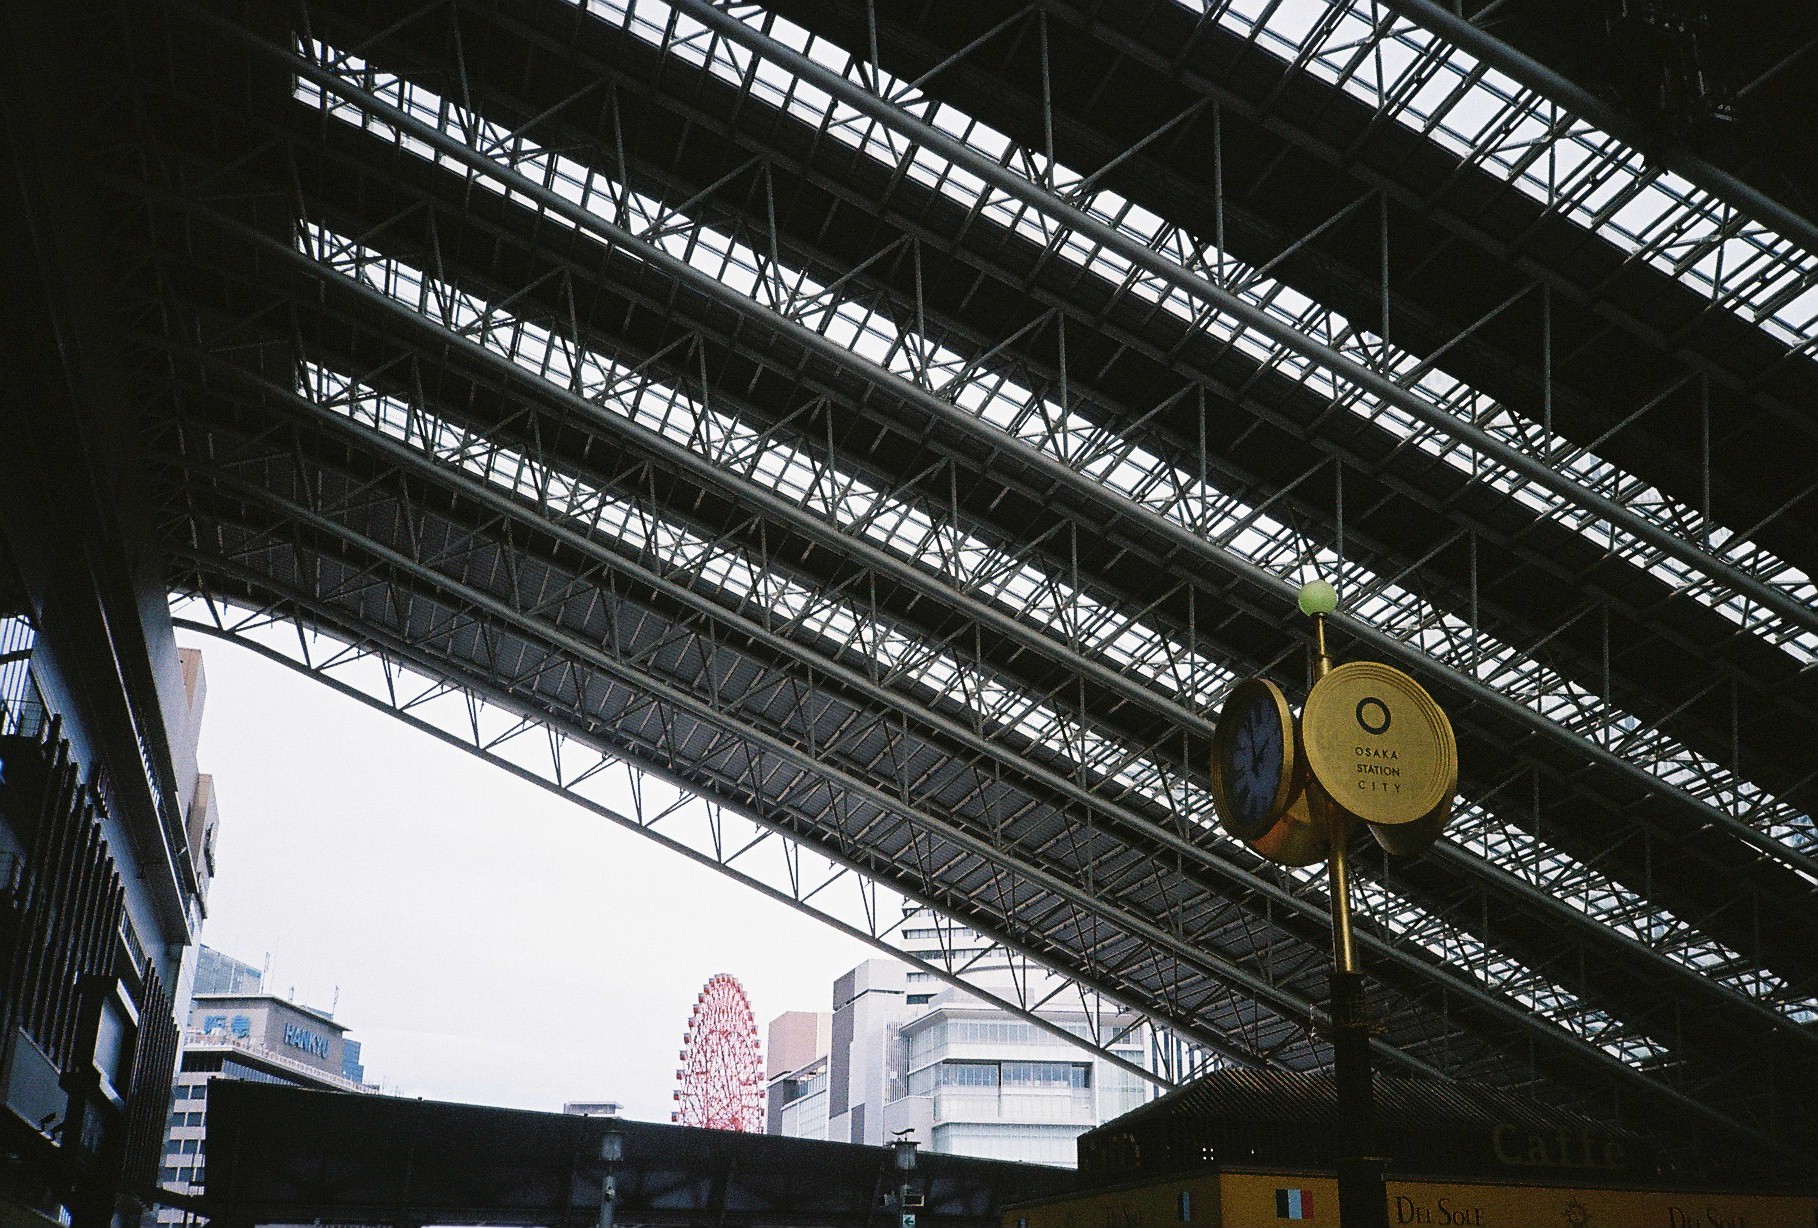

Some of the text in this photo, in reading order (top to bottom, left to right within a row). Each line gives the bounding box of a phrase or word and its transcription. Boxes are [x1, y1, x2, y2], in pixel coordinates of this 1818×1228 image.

[1355, 746, 1398, 760] OSAKA
[1357, 763, 1400, 777] STATION
[1358, 780, 1400, 793] CITY
[284, 1022, 329, 1060] HANKYU
